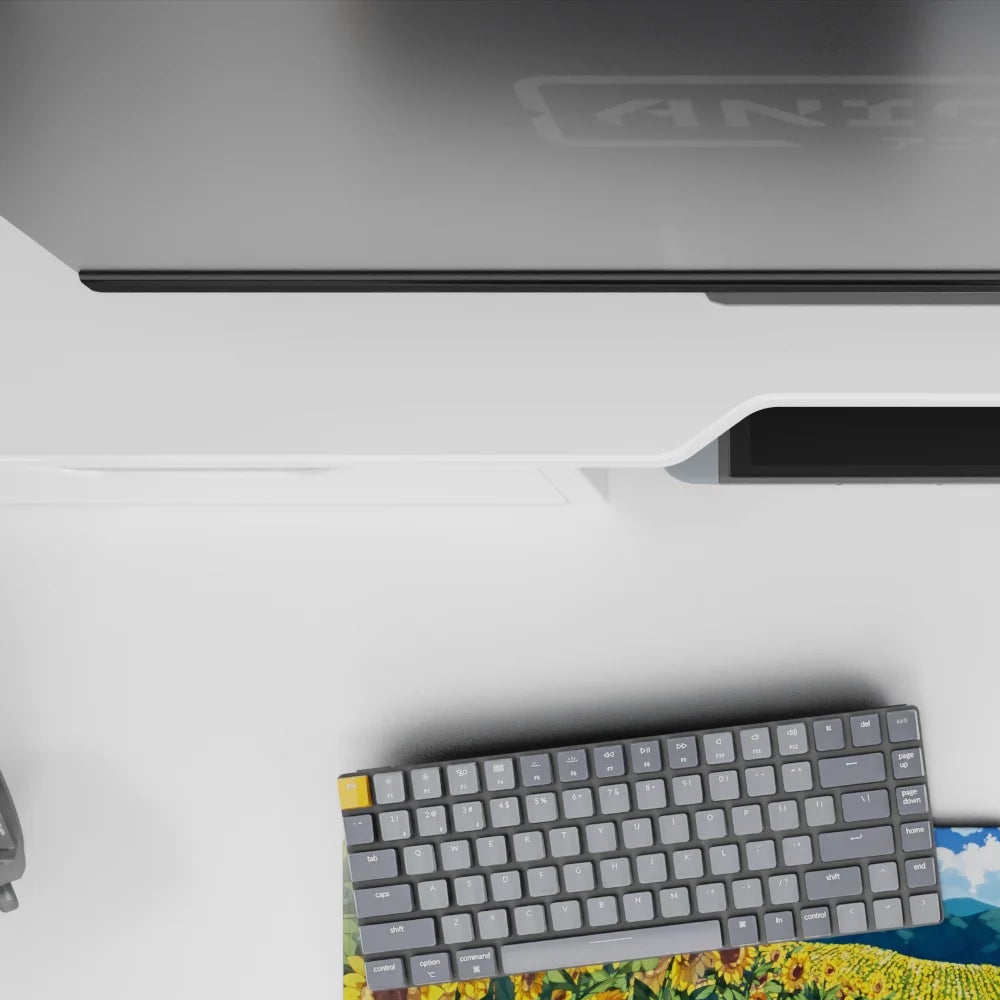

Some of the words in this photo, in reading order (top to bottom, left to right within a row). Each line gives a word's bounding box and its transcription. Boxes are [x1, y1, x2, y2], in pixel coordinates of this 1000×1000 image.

[860, 719, 871, 728] del
[898, 752, 915, 760] page
[901, 789, 918, 797] page
[902, 796, 922, 805] down
[905, 827, 925, 835] home
[366, 854, 378, 862] tab
[913, 862, 927, 871] end
[825, 873, 841, 881] shift
[374, 891, 391, 899] caps
[803, 911, 827, 921] control
[389, 925, 405, 934] shift
[459, 951, 491, 963] command
[372, 963, 396, 973] control
[419, 959, 441, 968] option
